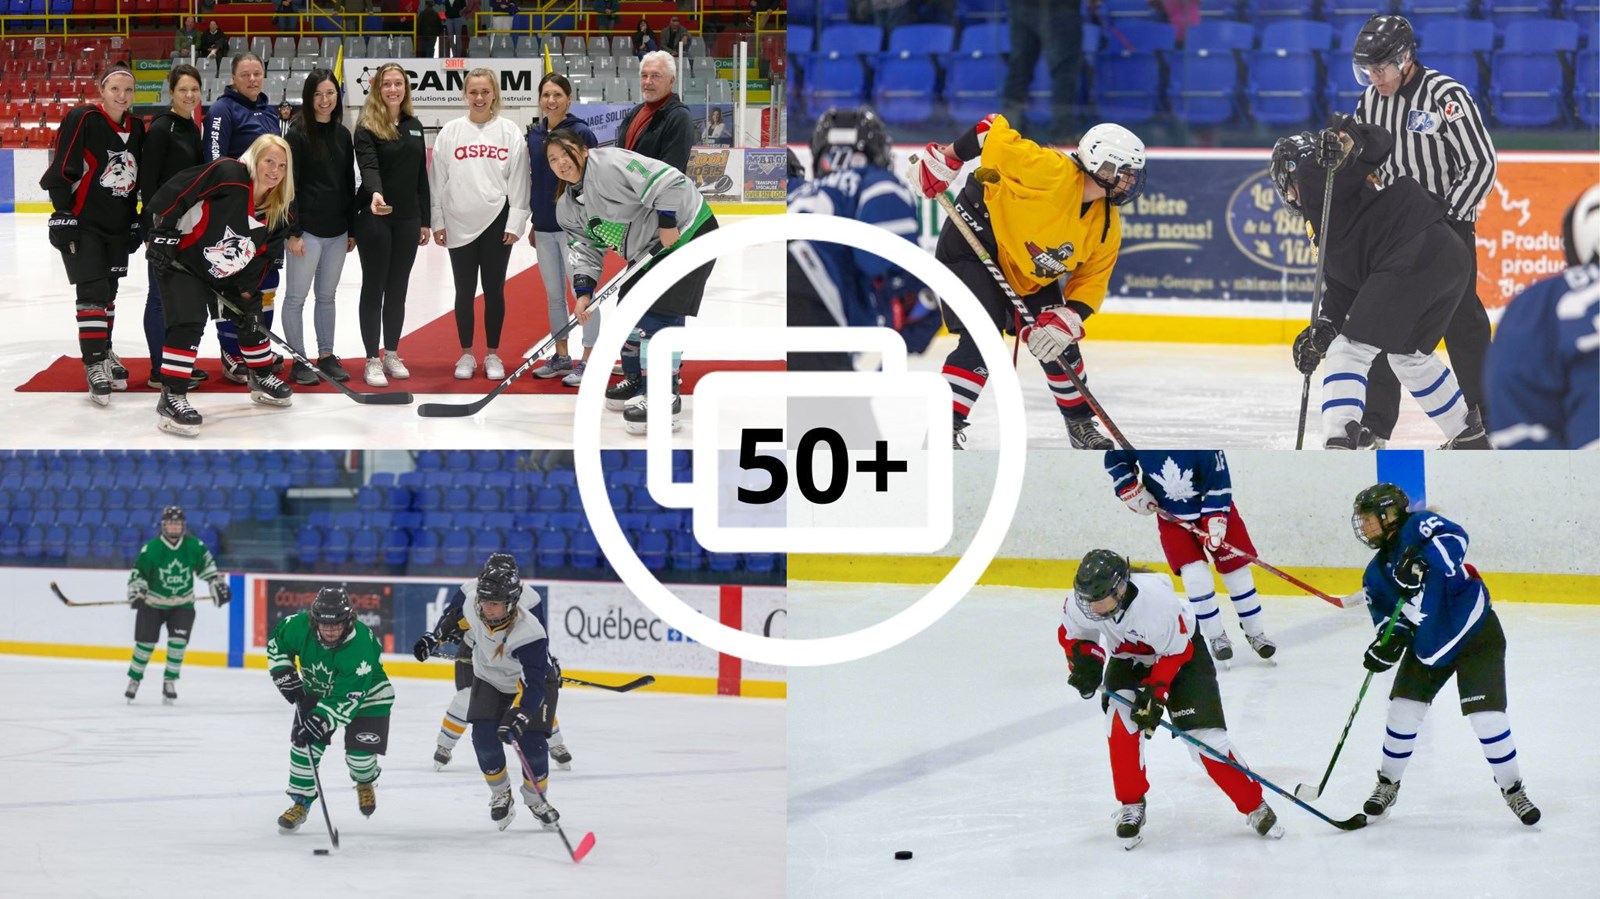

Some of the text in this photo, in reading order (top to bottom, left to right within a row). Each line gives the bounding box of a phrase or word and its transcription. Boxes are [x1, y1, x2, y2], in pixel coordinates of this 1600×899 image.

[444, 58, 465, 69] SORTIE
[447, 95, 464, 104] pou
[1108, 153, 1124, 162] CCM
[626, 159, 651, 178] 7
[1138, 193, 1188, 215] bière
[954, 203, 984, 232] CCM
[1121, 217, 1213, 239] hez nous!
[1418, 516, 1448, 539] 65
[563, 605, 662, 645] Québec
[1171, 707, 1196, 719] Reebok
